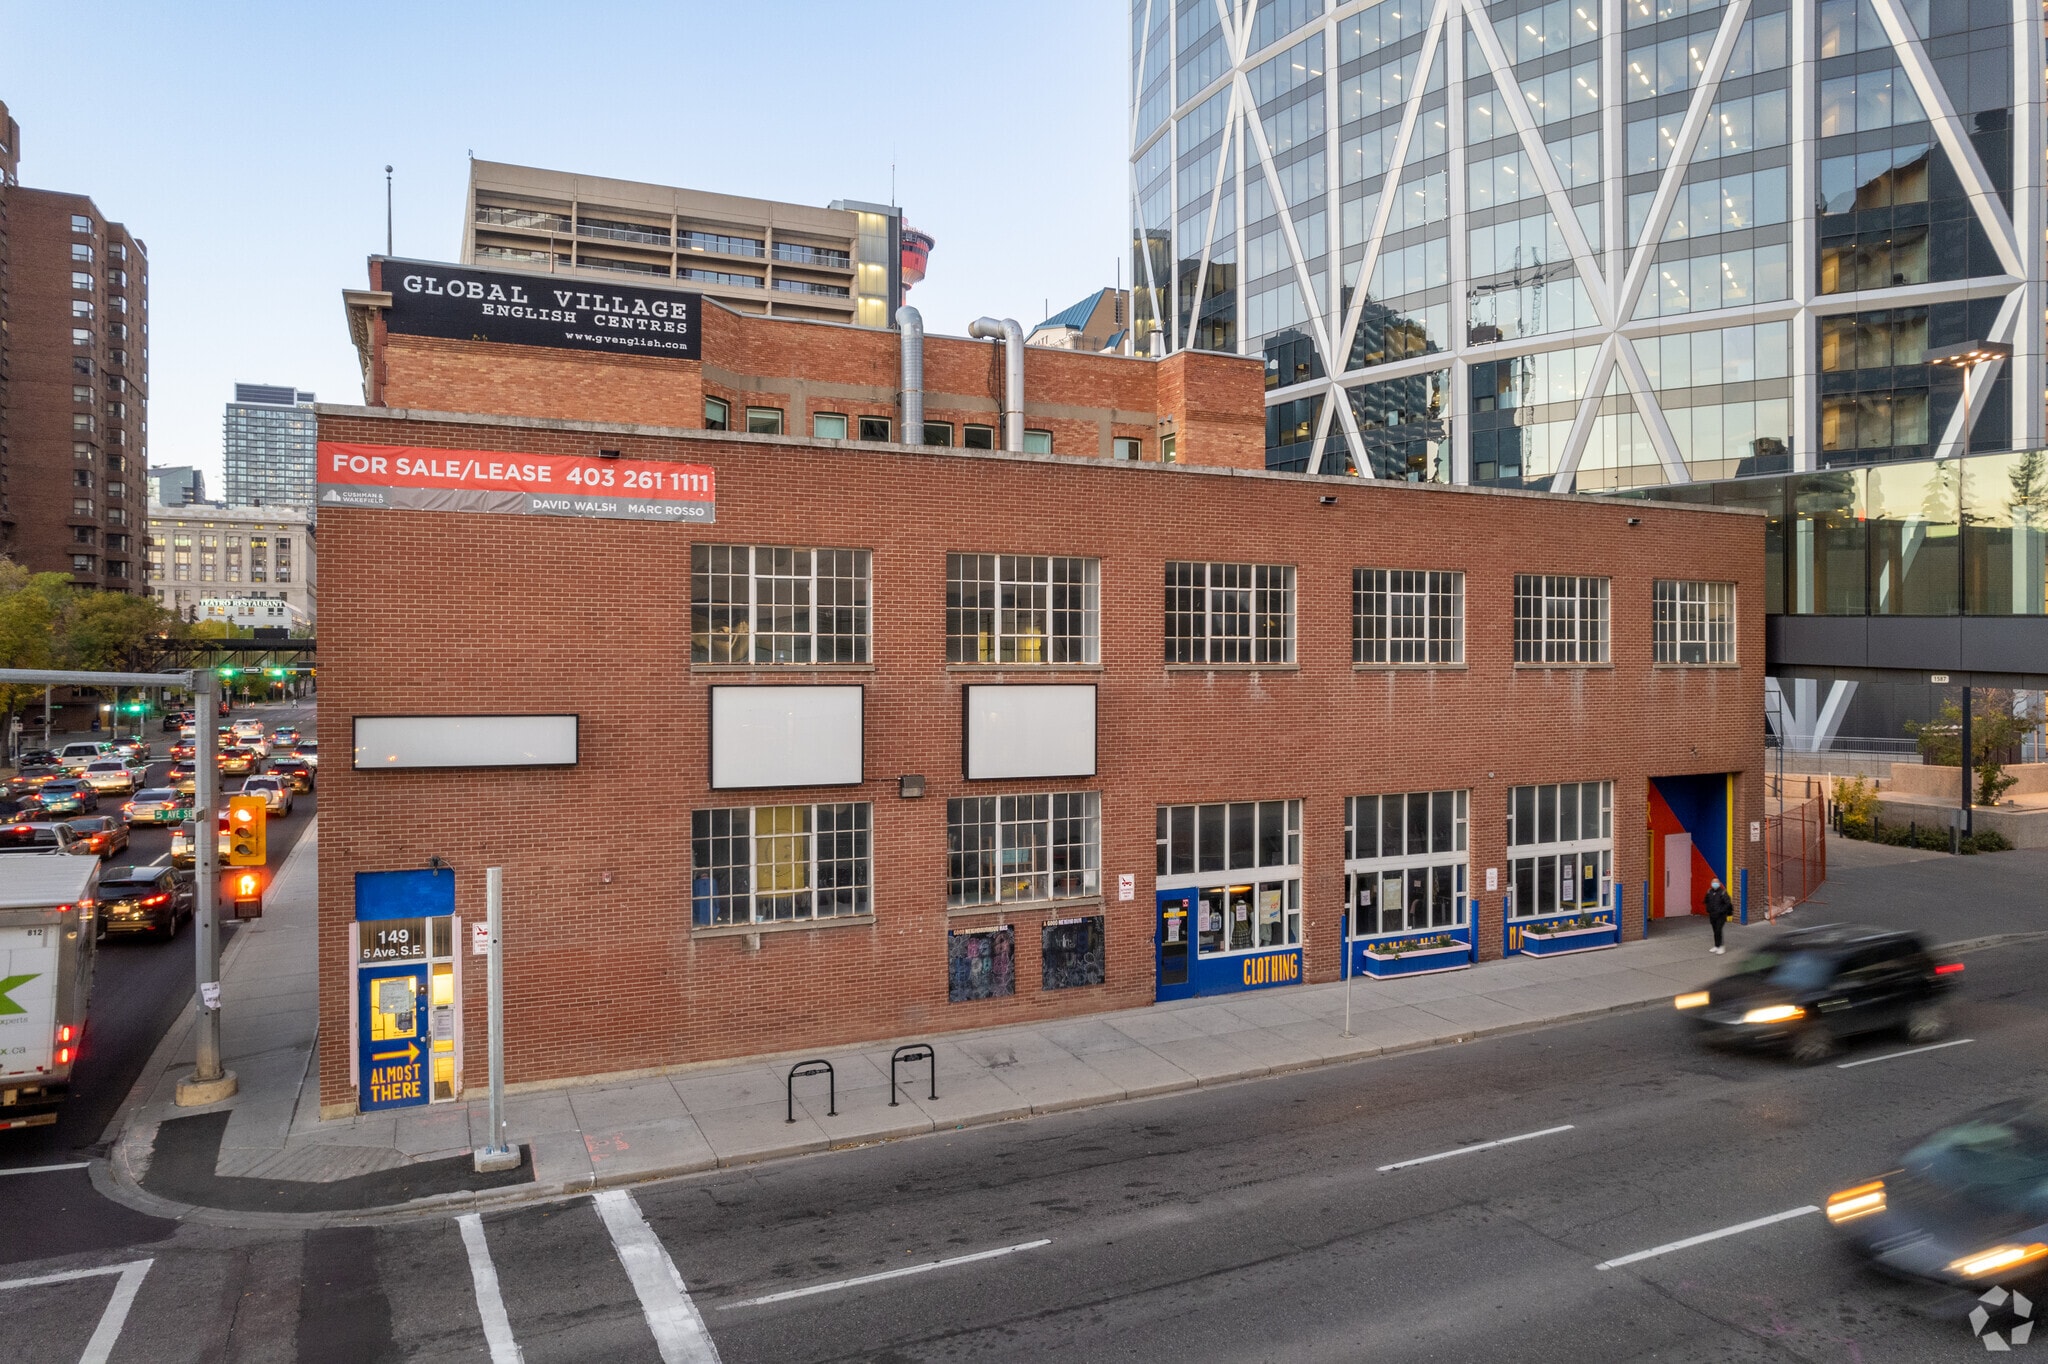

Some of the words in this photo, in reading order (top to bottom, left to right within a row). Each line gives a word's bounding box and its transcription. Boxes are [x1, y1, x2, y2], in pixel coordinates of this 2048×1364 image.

[403, 275, 528, 303] GLOBAL
[553, 290, 687, 320] VILLAGE
[482, 303, 577, 323] ENGLISH
[594, 315, 687, 334] CENTRES
[565, 332, 688, 350] www.gvenglish.com
[333, 454, 388, 475] FOR
[396, 457, 552, 483] SALE/LEASE
[566, 467, 615, 487] 403
[623, 470, 663, 490] 261
[670, 473, 708, 492] 1111
[532, 499, 571, 510] DAVID
[574, 501, 617, 512] WALSH
[628, 504, 662, 514] MARC
[665, 506, 705, 517] ROSSO
[232, 600, 284, 608] RESTAURANT
[156, 811, 163, 819] 5
[167, 809, 181, 819] AVE
[183, 809, 193, 818] SE
[378, 929, 409, 944] 149
[363, 948, 371, 958] 5
[373, 947, 399, 957] Ave.
[400, 945, 424, 956] S.E.
[1243, 953, 1298, 985] CLOTHING
[371, 1063, 421, 1084] ALMOST
[370, 1081, 421, 1102] THERE
